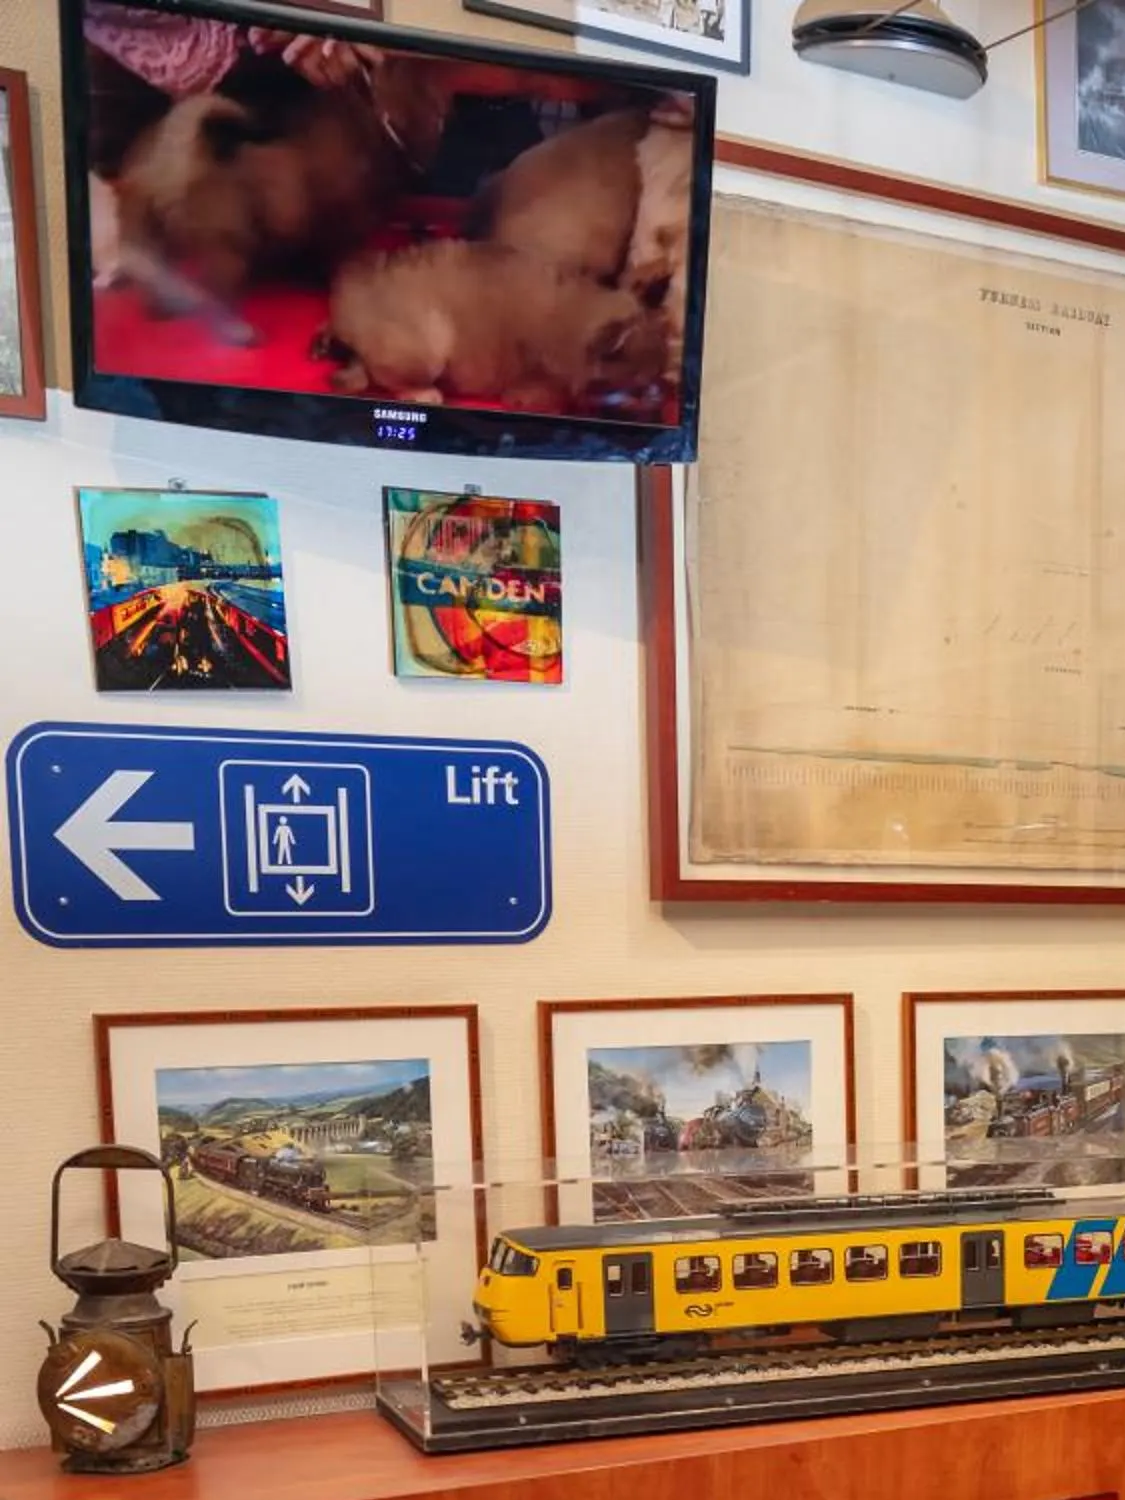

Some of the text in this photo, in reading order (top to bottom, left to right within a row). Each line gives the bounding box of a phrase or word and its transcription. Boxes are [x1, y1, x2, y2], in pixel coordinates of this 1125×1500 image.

[373, 408, 428, 423] SAMSUNG
[377, 425, 416, 440] 17:25
[417, 572, 545, 604] CAMDEN
[446, 764, 519, 805] Lift
